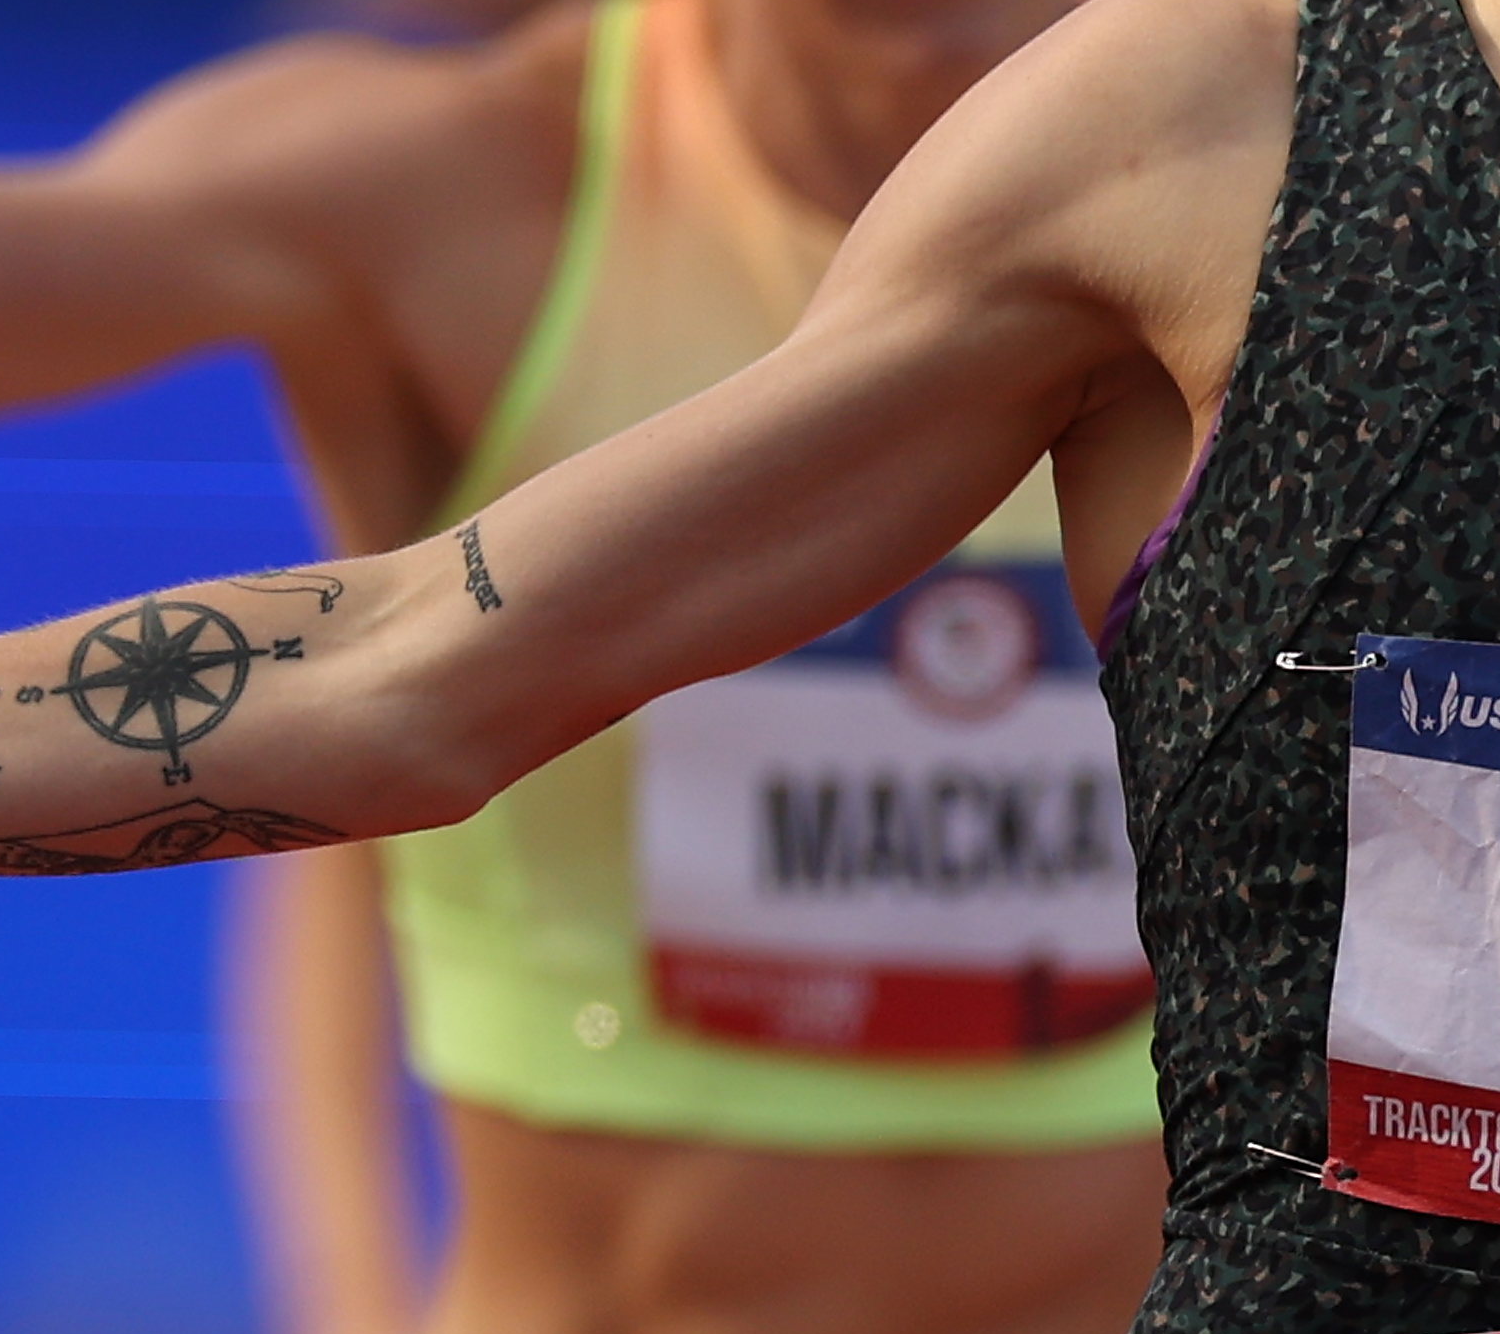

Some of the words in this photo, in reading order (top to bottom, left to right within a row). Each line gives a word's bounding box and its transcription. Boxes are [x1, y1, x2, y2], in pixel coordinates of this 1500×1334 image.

[454, 520, 503, 613] younger
[272, 636, 304, 661] N
[15, 684, 45, 704] S
[162, 761, 192, 786] E
[757, 765, 1111, 897] MACKA
